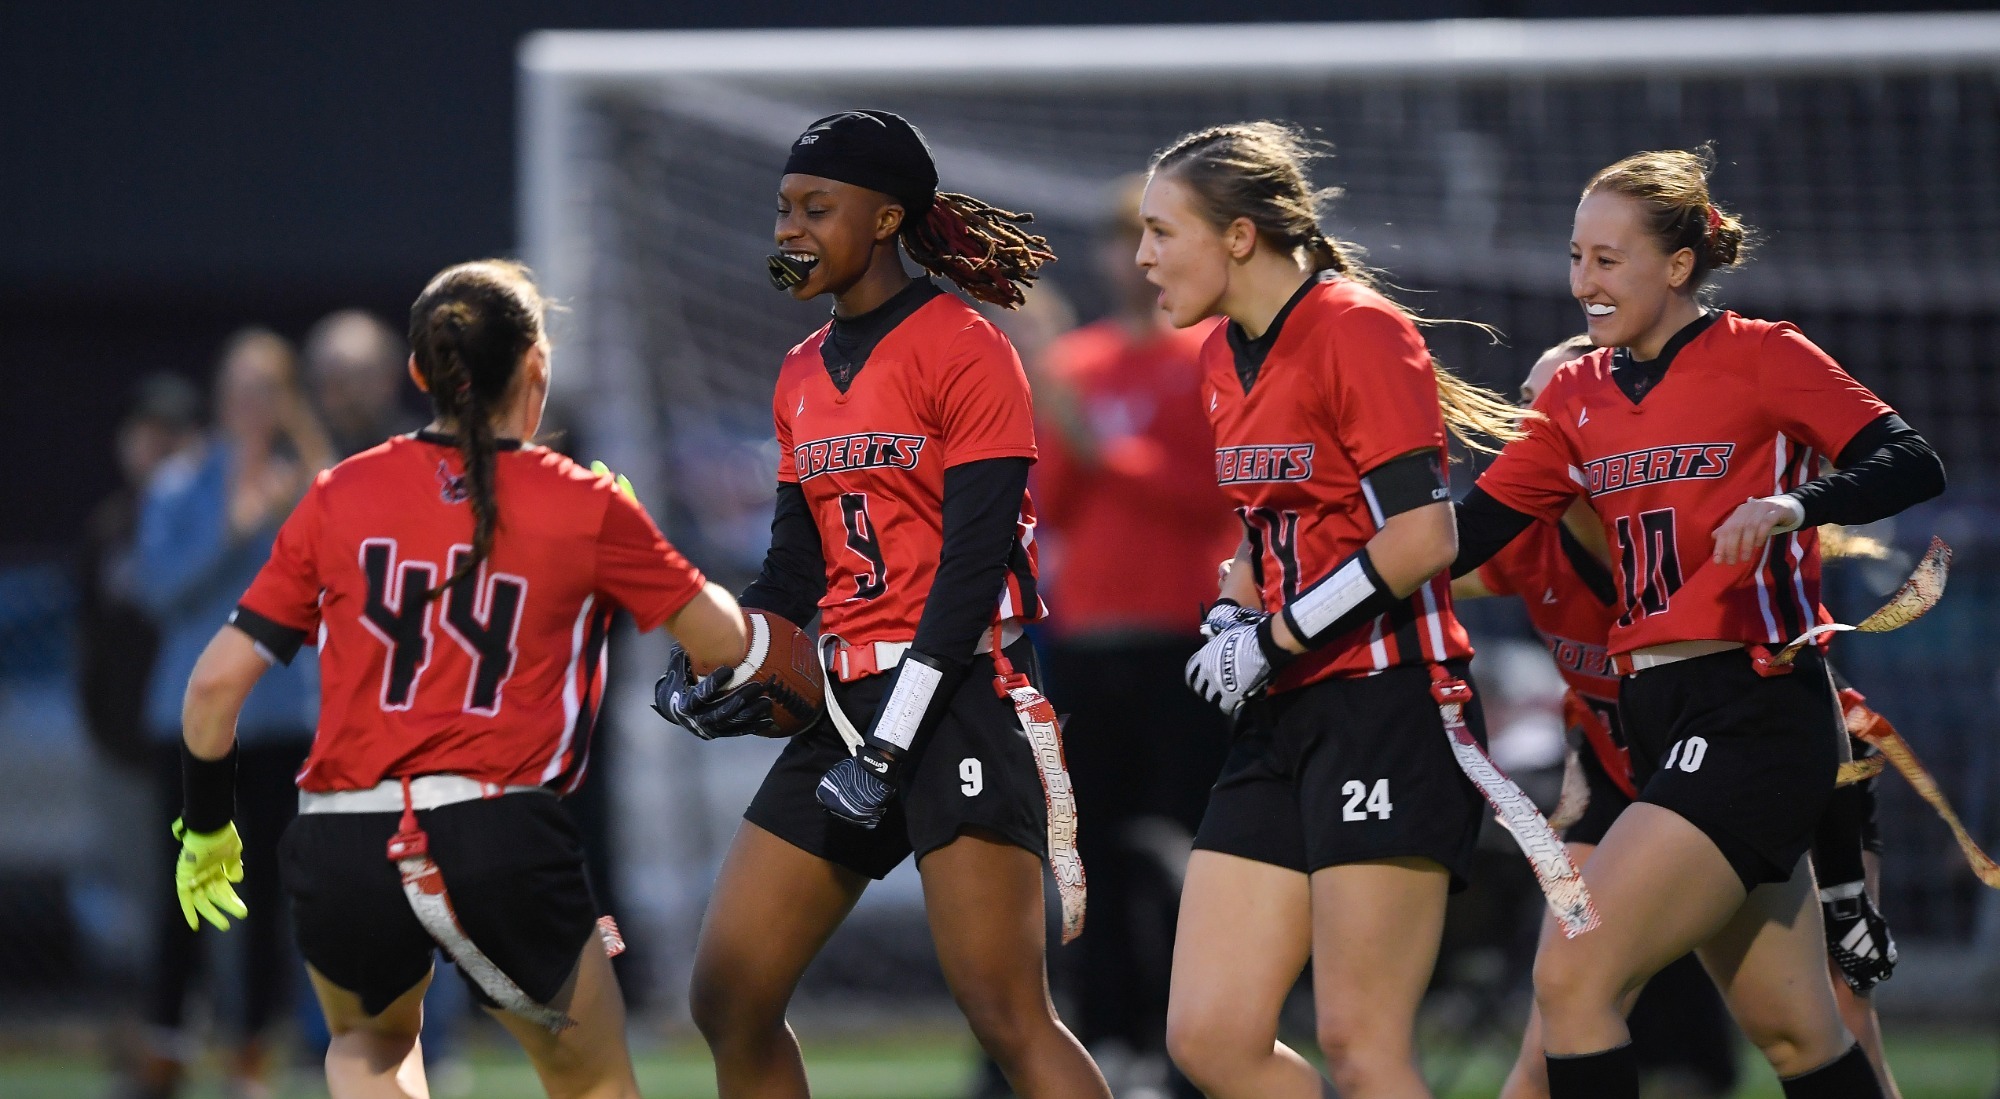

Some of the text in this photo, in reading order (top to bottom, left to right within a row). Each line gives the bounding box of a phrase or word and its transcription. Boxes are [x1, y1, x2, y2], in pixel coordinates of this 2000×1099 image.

[794, 432, 926, 484] OBERTS
[1215, 443, 1315, 486] BERTS
[1582, 443, 1736, 498] OBERTS
[839, 492, 889, 602] 9
[1615, 507, 1684, 628] 10
[359, 538, 528, 717] 44
[958, 757, 983, 797] 9
[1664, 735, 1708, 773] 10
[1027, 720, 1082, 888] ROBERTS
[1342, 778, 1393, 822] 24
[1456, 746, 1575, 881] ROBERTS
